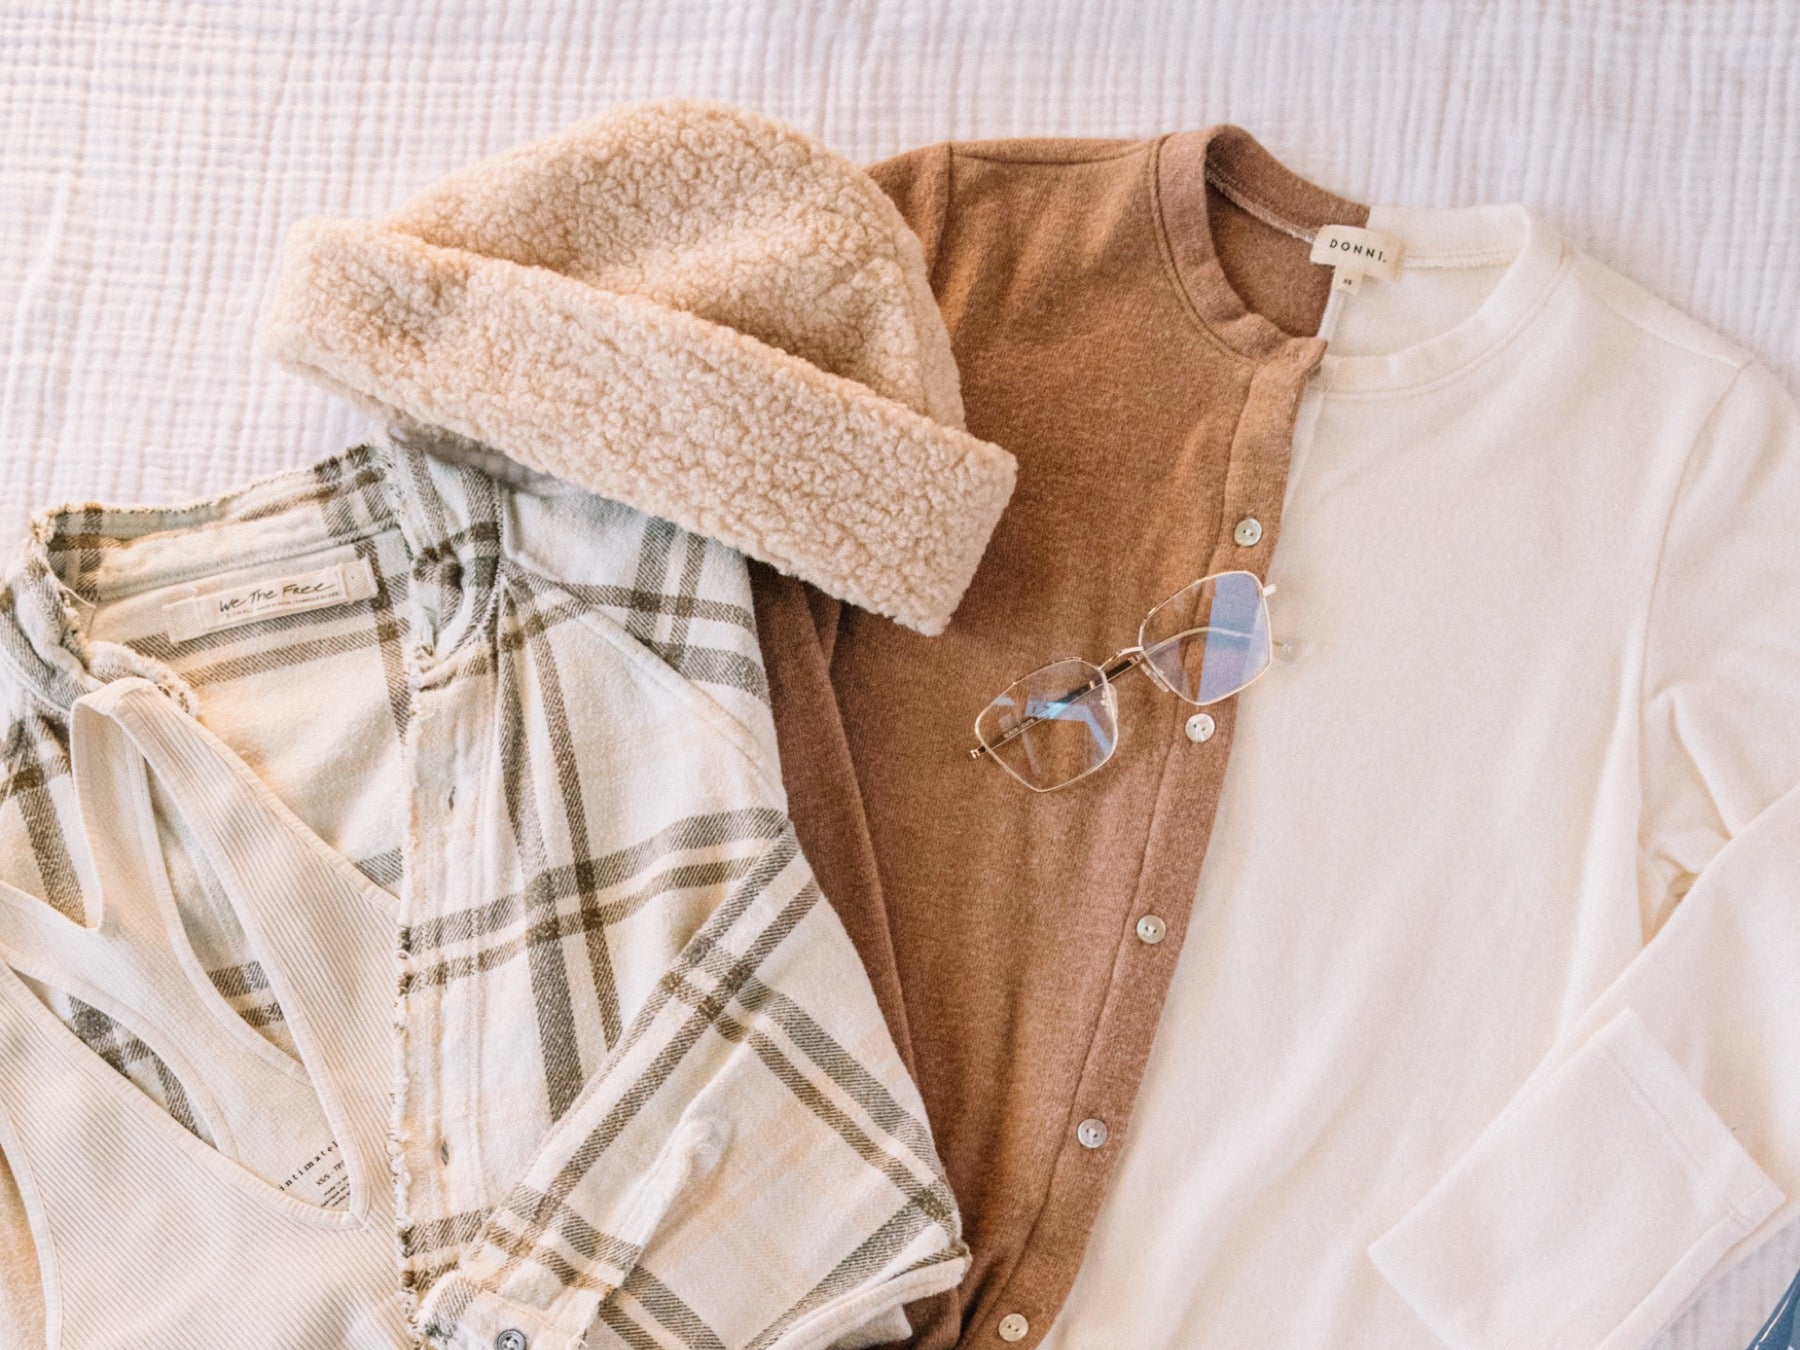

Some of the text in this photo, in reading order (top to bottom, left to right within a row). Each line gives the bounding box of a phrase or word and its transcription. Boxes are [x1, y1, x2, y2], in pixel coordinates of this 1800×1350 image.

[1329, 239, 1387, 263] DONNI.
[219, 597, 248, 613] We
[249, 588, 278, 603] The
[282, 581, 336, 597] Free
[279, 1140, 339, 1192] intimatel
